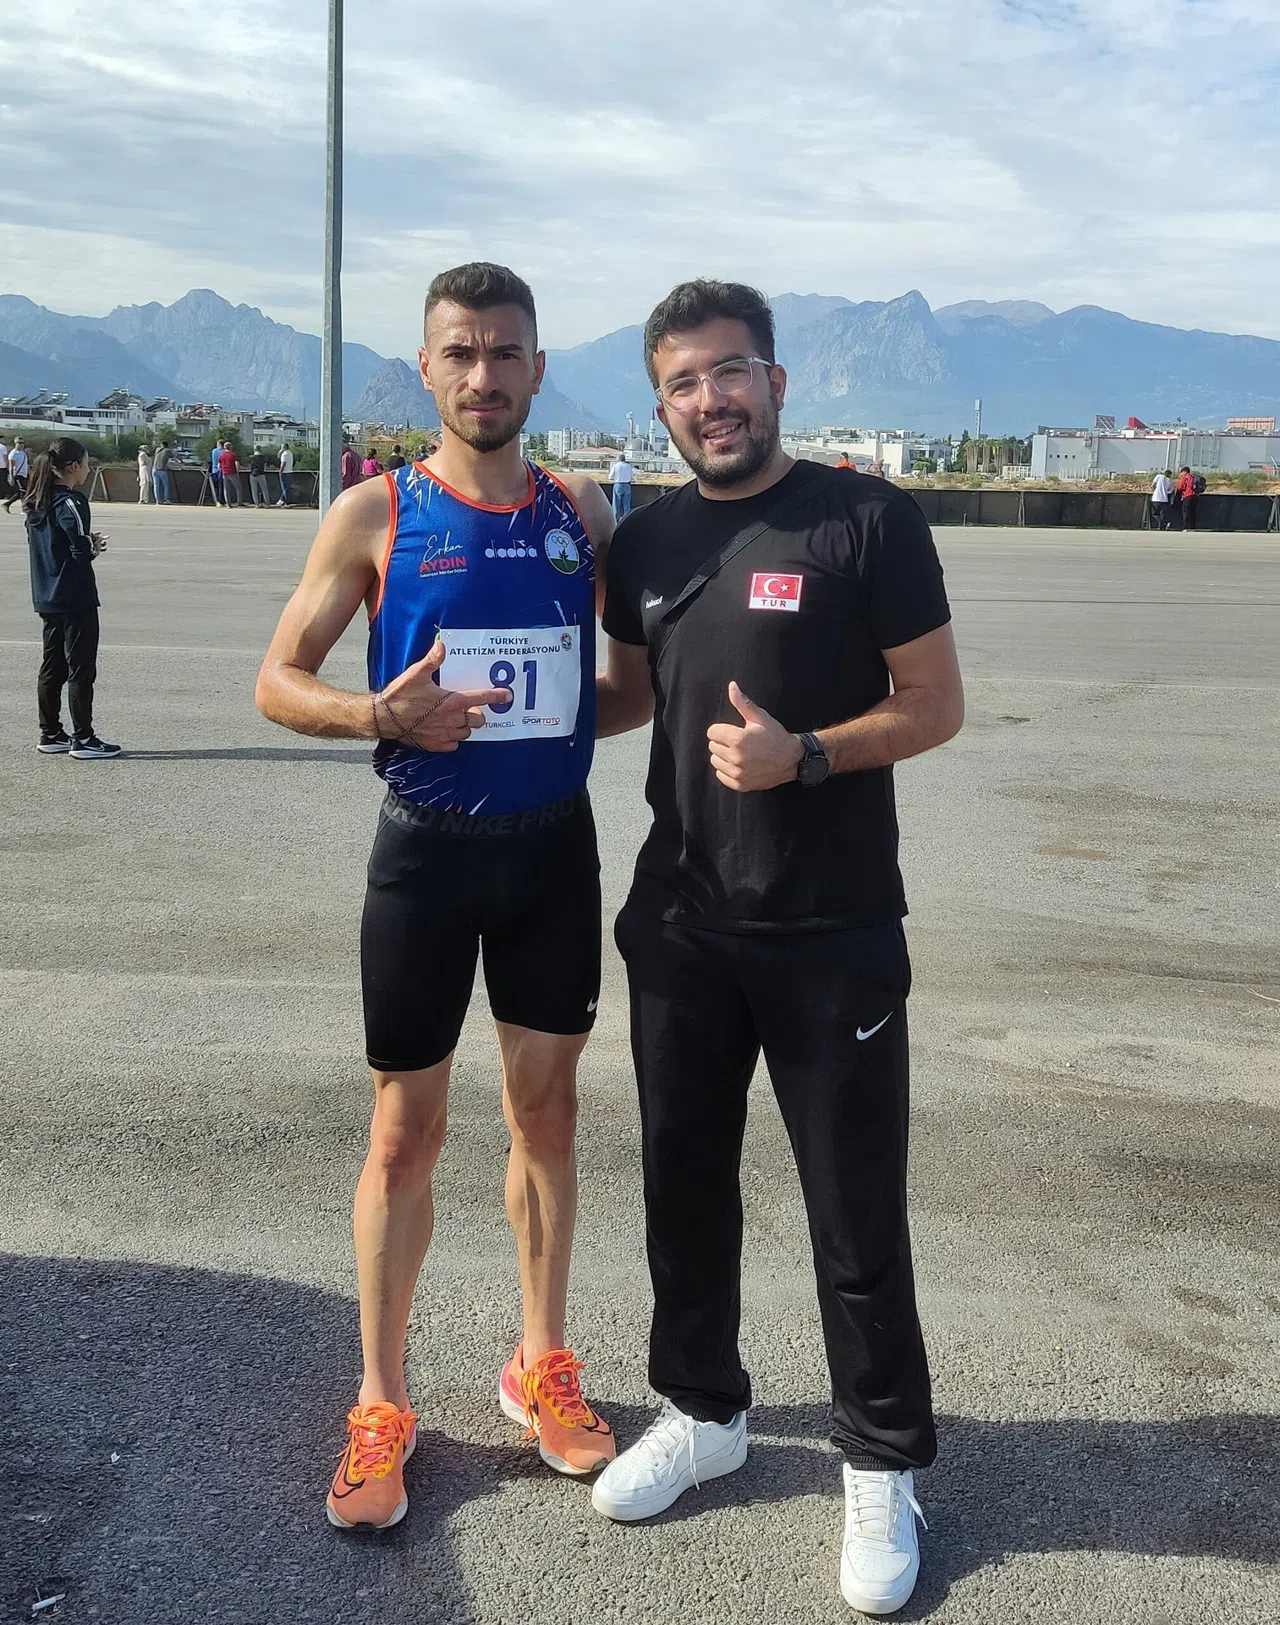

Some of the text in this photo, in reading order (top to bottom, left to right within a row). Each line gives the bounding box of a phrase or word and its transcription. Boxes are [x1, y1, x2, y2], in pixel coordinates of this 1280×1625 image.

[423, 531, 463, 562] Erkan
[485, 539, 538, 558] diadora
[420, 556, 467, 573] AYDIN
[761, 599, 787, 608] TUR
[489, 635, 529, 645] TÜRKİYE
[450, 645, 561, 656] ATLETİZM FEDERASYONU
[489, 660, 538, 714] 81
[485, 720, 515, 728] TURKCELL
[384, 790, 575, 836] PRO NIKE PRO
